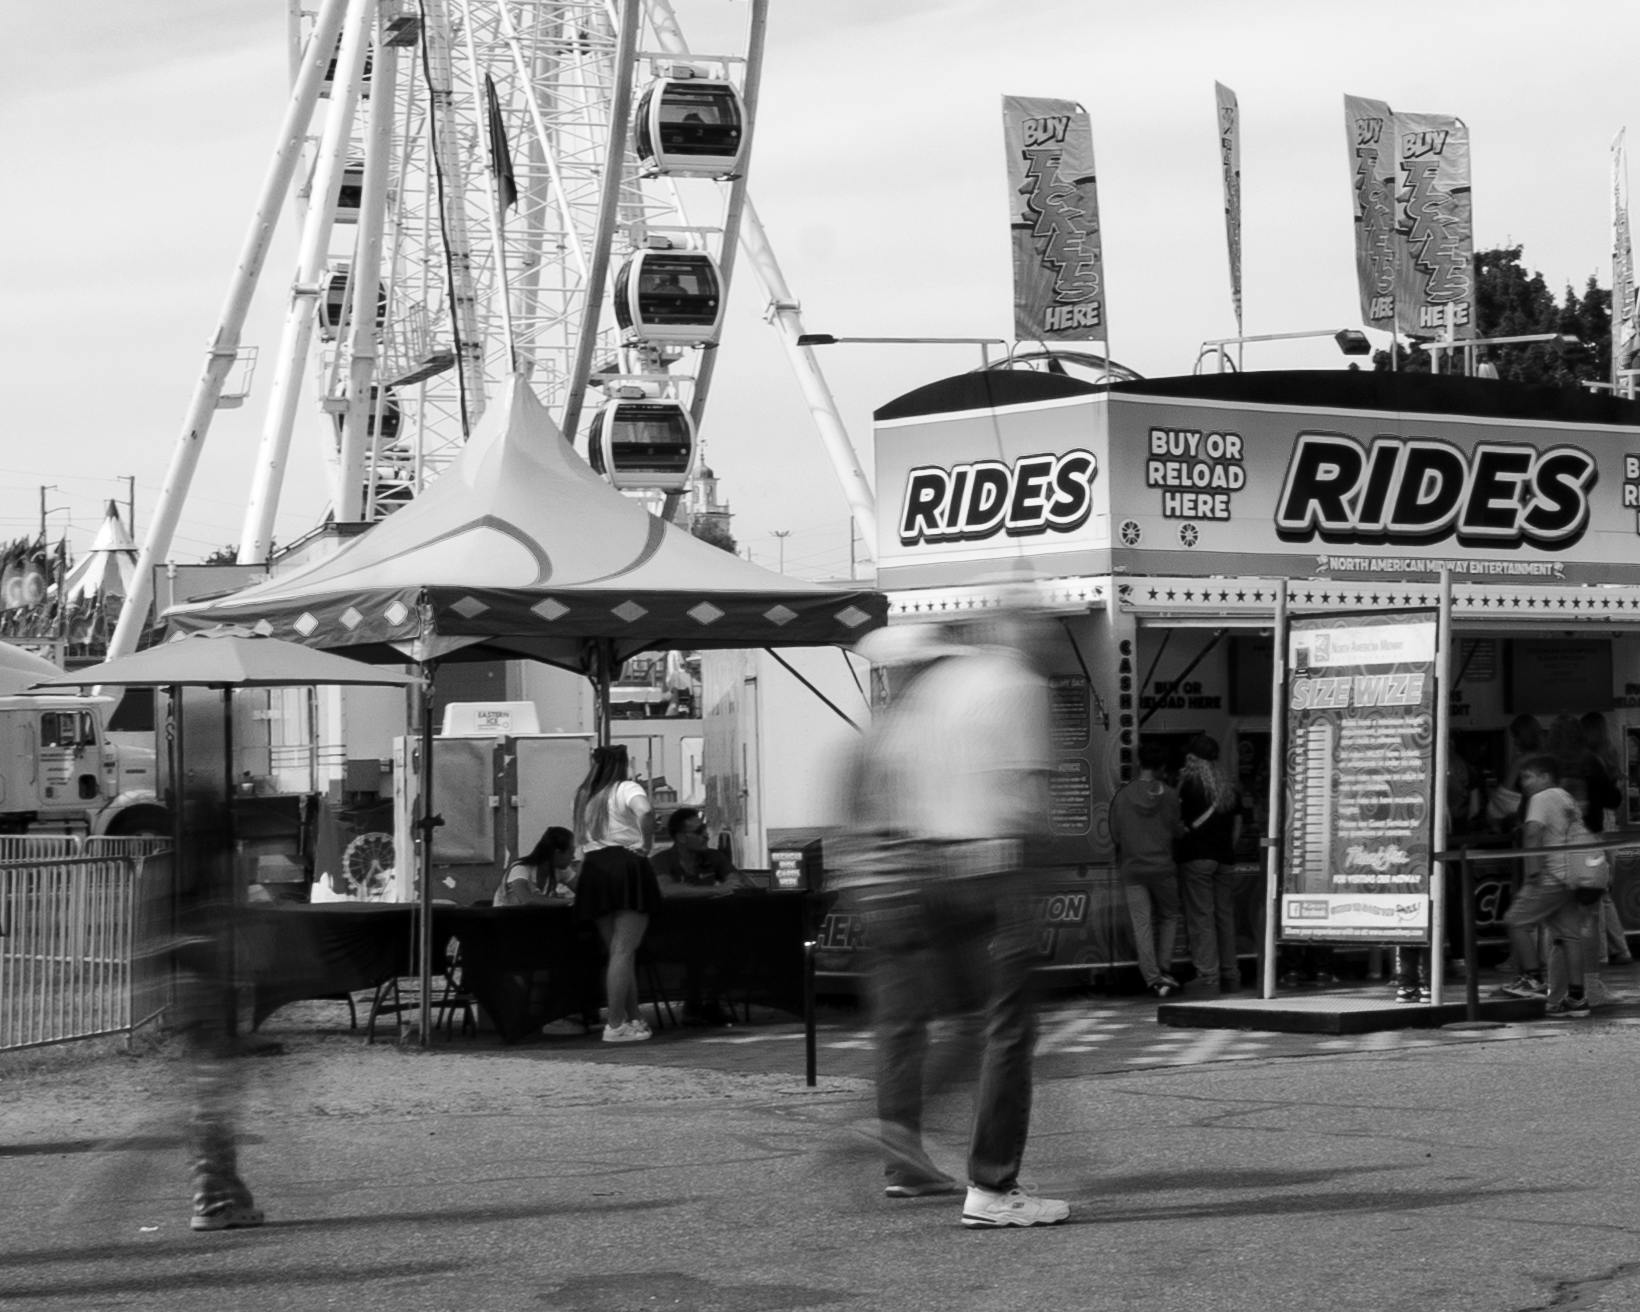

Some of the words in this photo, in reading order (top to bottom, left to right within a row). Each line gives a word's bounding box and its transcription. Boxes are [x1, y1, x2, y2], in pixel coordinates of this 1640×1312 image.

[1022, 115, 1070, 147] BUY
[1355, 118, 1383, 146] BUY
[1402, 130, 1449, 159] BUY
[1043, 302, 1100, 333] HERE
[1150, 430, 1201, 457] BUY
[1206, 434, 1244, 460] OR
[1148, 461, 1246, 489] RELOAD
[899, 449, 1098, 546] RIDES
[1165, 492, 1230, 519] HERE
[1275, 431, 1599, 552] RIDES
[1329, 558, 1369, 572] NORTH
[1370, 559, 1425, 573] AMERICAN
[1426, 561, 1469, 574] MIDWAY
[1470, 562, 1554, 576] ENTERTAINMENT
[1290, 677, 1352, 710] SIZE
[1353, 673, 1425, 707] WIZE
